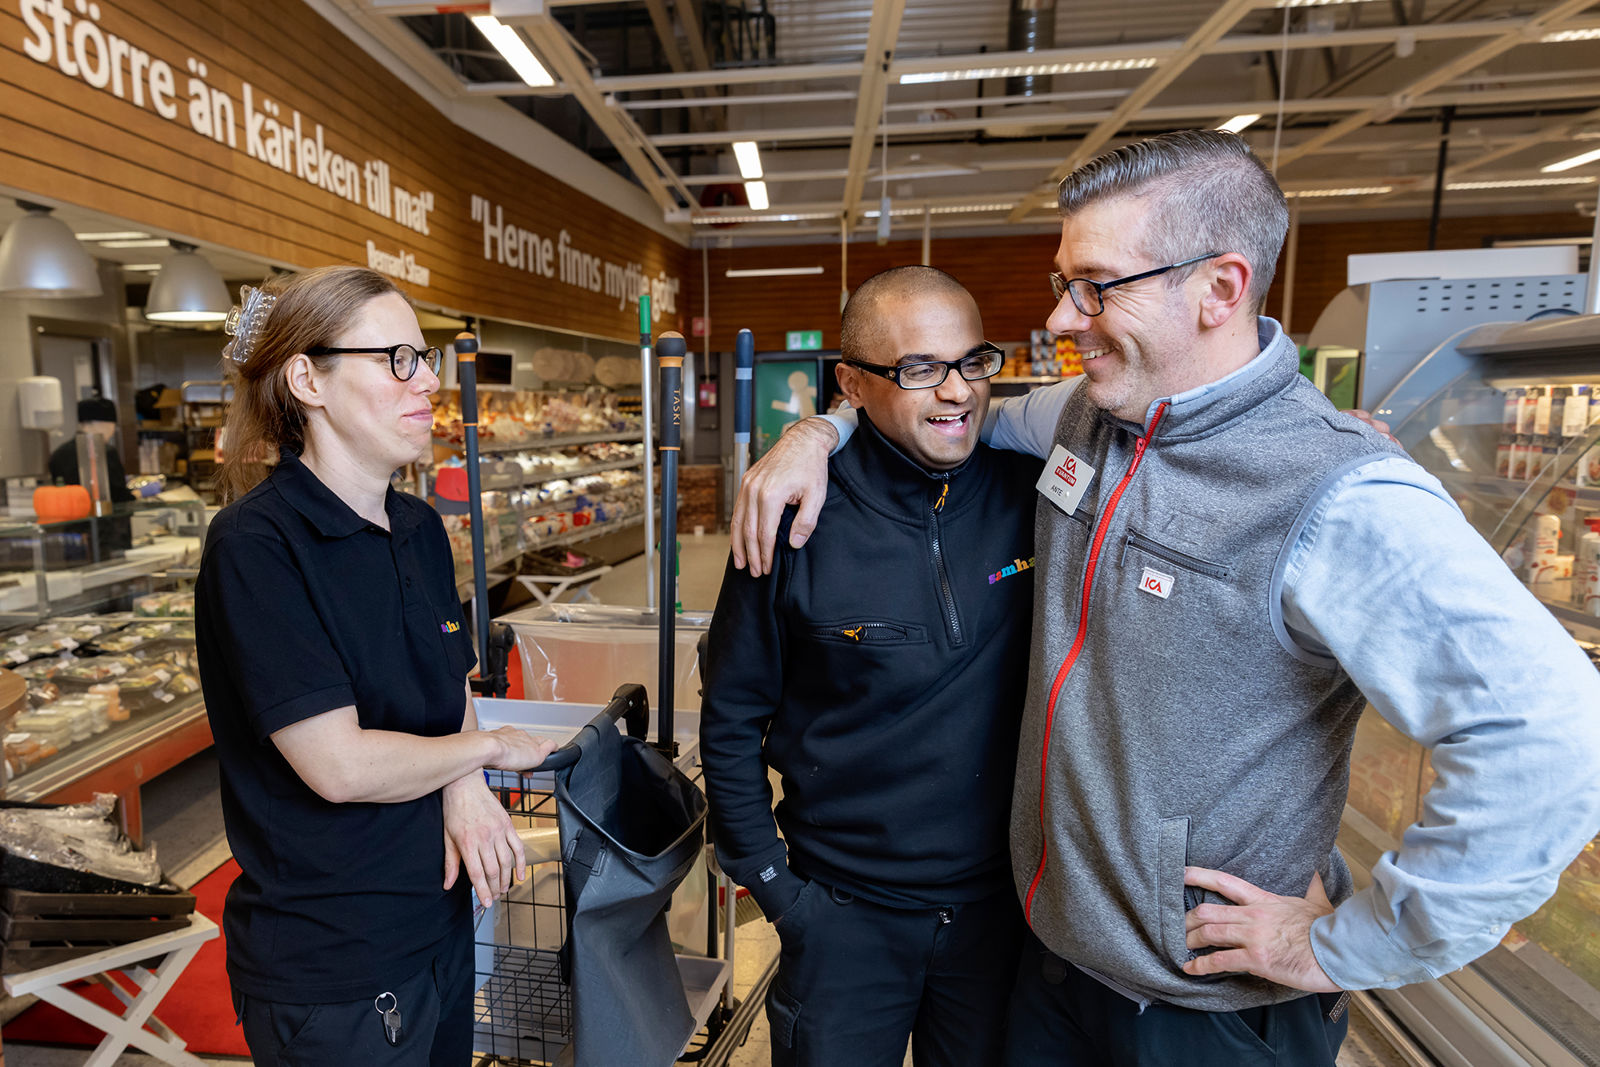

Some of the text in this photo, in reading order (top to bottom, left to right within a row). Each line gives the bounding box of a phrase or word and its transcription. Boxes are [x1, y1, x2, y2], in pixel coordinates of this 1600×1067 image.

[20, 0, 177, 119] större
[187, 57, 237, 148] än
[243, 82, 361, 205] kärleken
[363, 160, 391, 218] till
[558, 229, 601, 293] finns
[673, 389, 681, 426] TASKI
[1062, 455, 1078, 475] ICA
[1144, 577, 1163, 593] ICA
